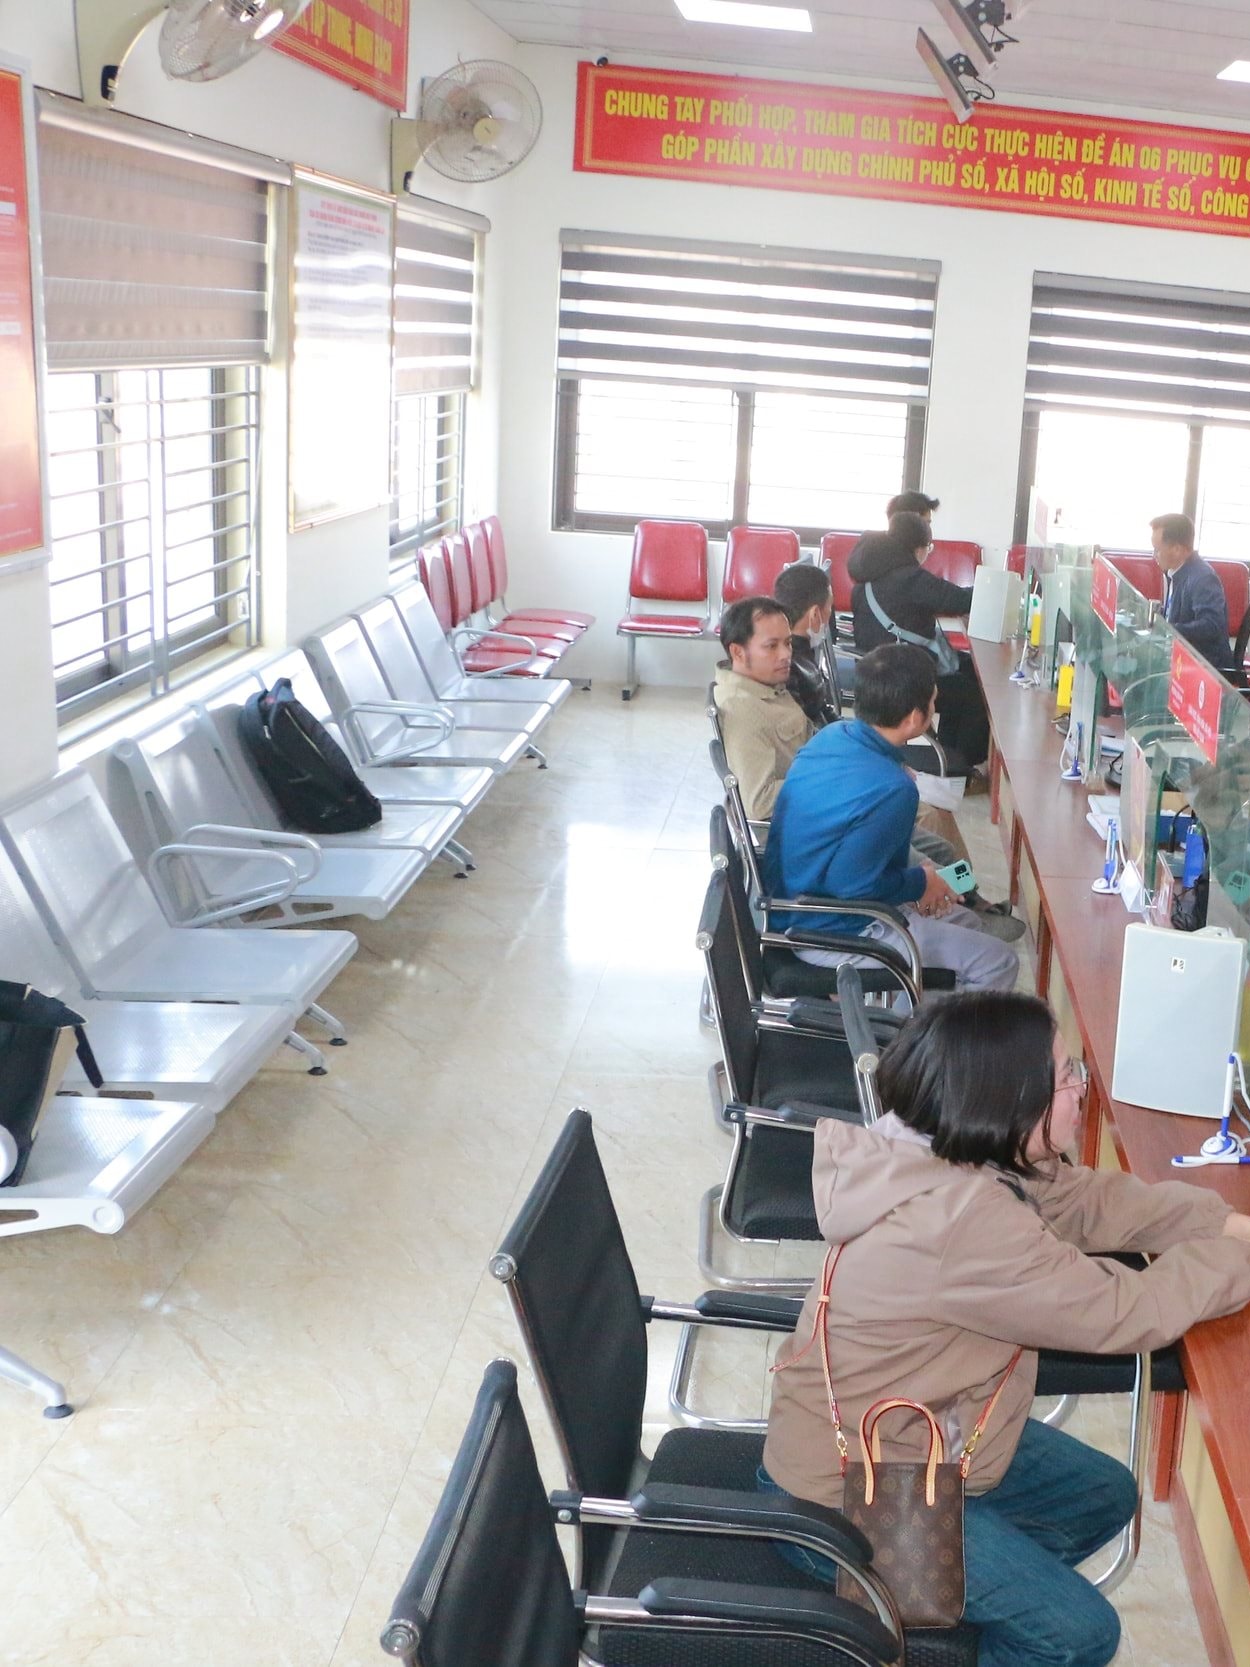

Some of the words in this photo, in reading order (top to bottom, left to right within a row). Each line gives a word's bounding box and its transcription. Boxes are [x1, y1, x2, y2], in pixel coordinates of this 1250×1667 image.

[604, 88, 669, 120] CHUNG
[675, 95, 703, 123] TAY
[710, 93, 753, 128] PHỐI
[804, 109, 855, 138] THAM
[861, 114, 891, 141] GIA
[898, 111, 937, 146] TÍCH
[942, 124, 979, 155] CỰC
[983, 128, 1030, 161] THỰC
[1035, 130, 1076, 165] HIỆN
[1082, 132, 1105, 165] ĐỀ
[1109, 139, 1134, 169] ÁN
[1140, 147, 1161, 171] 06
[1166, 148, 1213, 180] PHỤC
[1218, 155, 1241, 183] VỤ
[661, 131, 699, 163] GÓP
[704, 132, 752, 166] PHẦN
[760, 140, 797, 170] XÂY
[802, 147, 852, 179] DỰNG
[858, 149, 914, 183] CHÍNH
[919, 156, 955, 187] PHỦ
[961, 156, 990, 194] SỐ,
[995, 154, 1019, 192] XÃ
[1025, 164, 1055, 201] HỘI
[1060, 167, 1089, 204] SỐ,
[1095, 178, 1136, 206] KINH
[1141, 176, 1164, 209] TẾ
[1167, 175, 1196, 215] SỐ,
[1201, 189, 1249, 218] CÔNG
